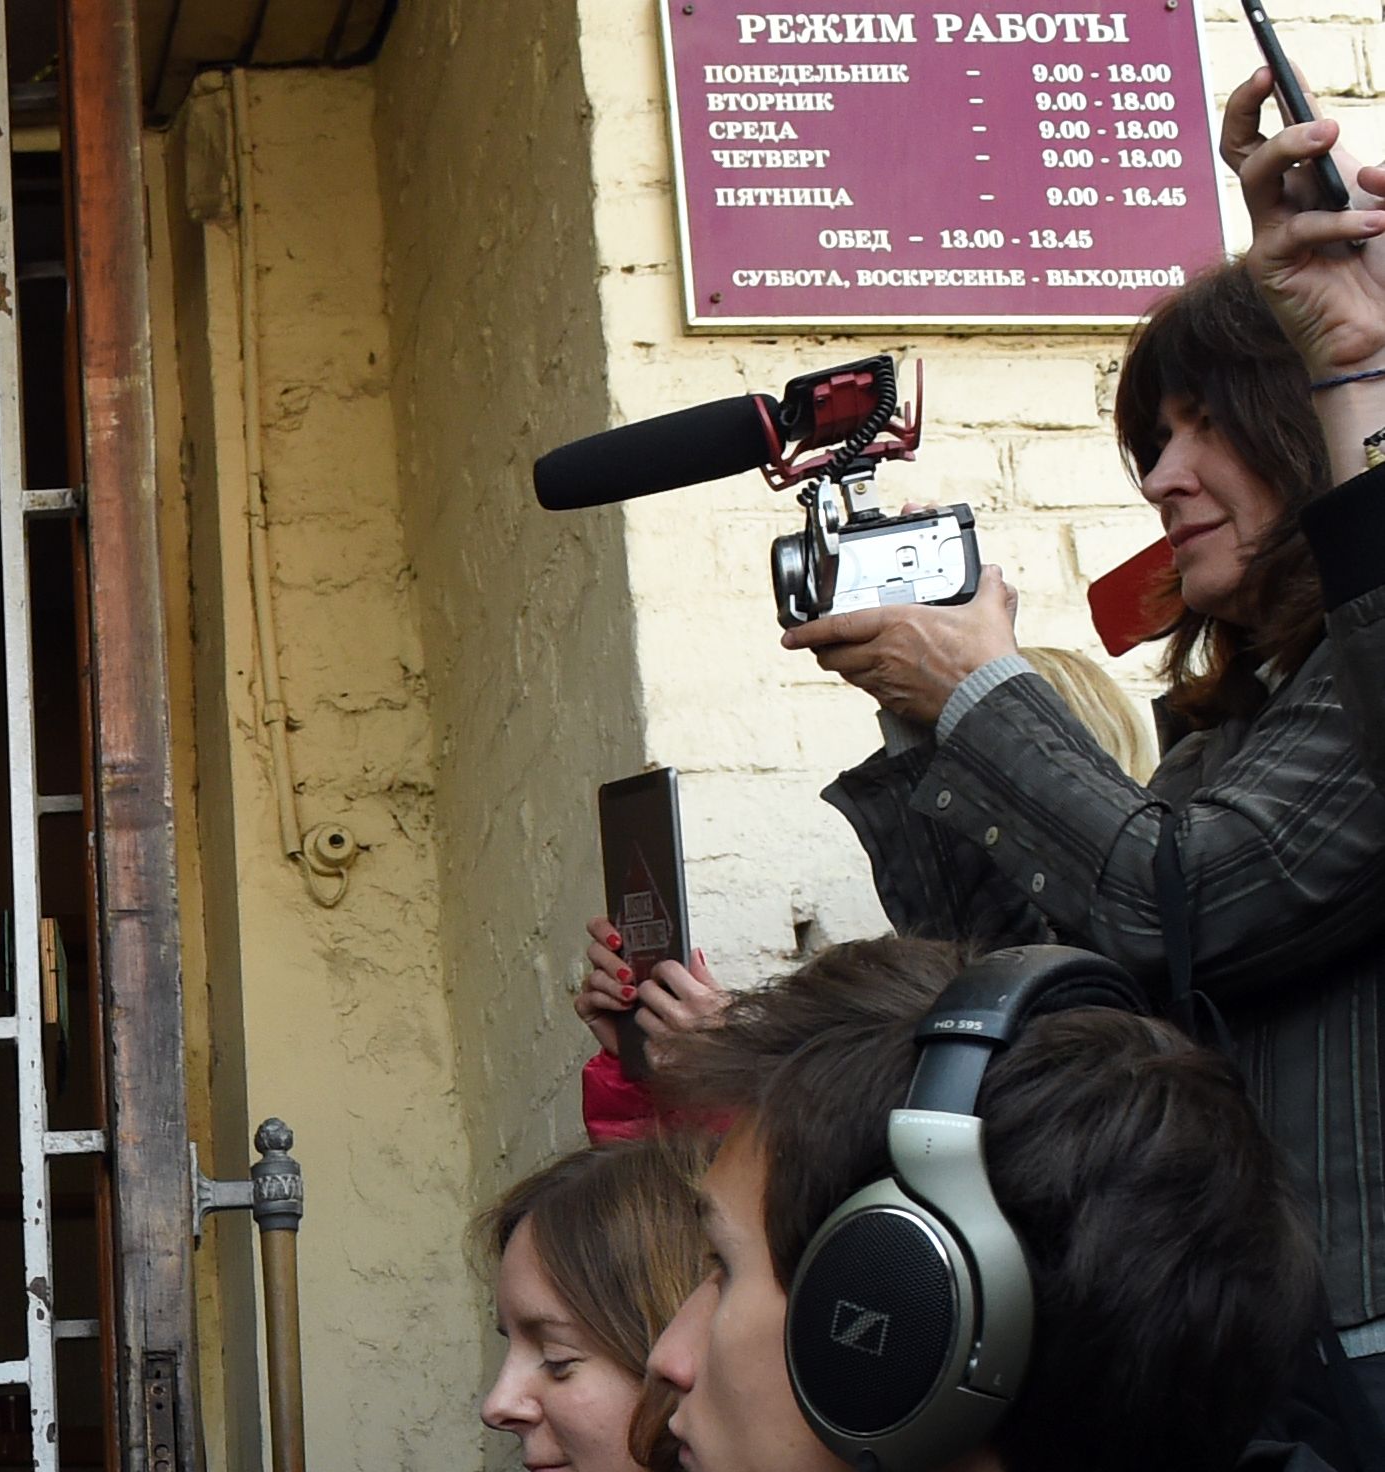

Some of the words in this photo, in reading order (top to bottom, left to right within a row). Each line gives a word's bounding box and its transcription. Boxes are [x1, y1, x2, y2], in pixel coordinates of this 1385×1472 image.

[736, 13, 918, 44] РЕЖИМ
[934, 13, 1130, 44] РАБОТЫ
[703, 64, 910, 86] ПОНЕДЕЛЬНИК
[1031, 63, 1084, 83] 9.00
[1107, 63, 1172, 83] 18.00
[705, 92, 835, 112] ВТОРНИК
[1035, 92, 1088, 112] 9.00
[1110, 92, 1176, 112] 18.00
[708, 120, 799, 143] СРЕДА
[1038, 120, 1091, 140] 9.00
[1113, 120, 1179, 140] 18.00
[710, 149, 831, 169] ЧЕТВЕРГ
[1041, 148, 1094, 169] 9.00
[1117, 148, 1183, 169] 18.00
[714, 187, 854, 210] ПЯТНИЦА
[1046, 186, 1099, 207] 9.00
[1121, 186, 1187, 207] 16.45
[818, 229, 892, 252] ОБЕД
[939, 229, 1005, 249] 13.00
[1028, 229, 1094, 249] 13.45
[731, 269, 851, 289] СУББОТА,
[856, 269, 1027, 289] ВОСКРЕСЕНЬЕ
[1046, 265, 1186, 290] ВЫХОДНОЙ
